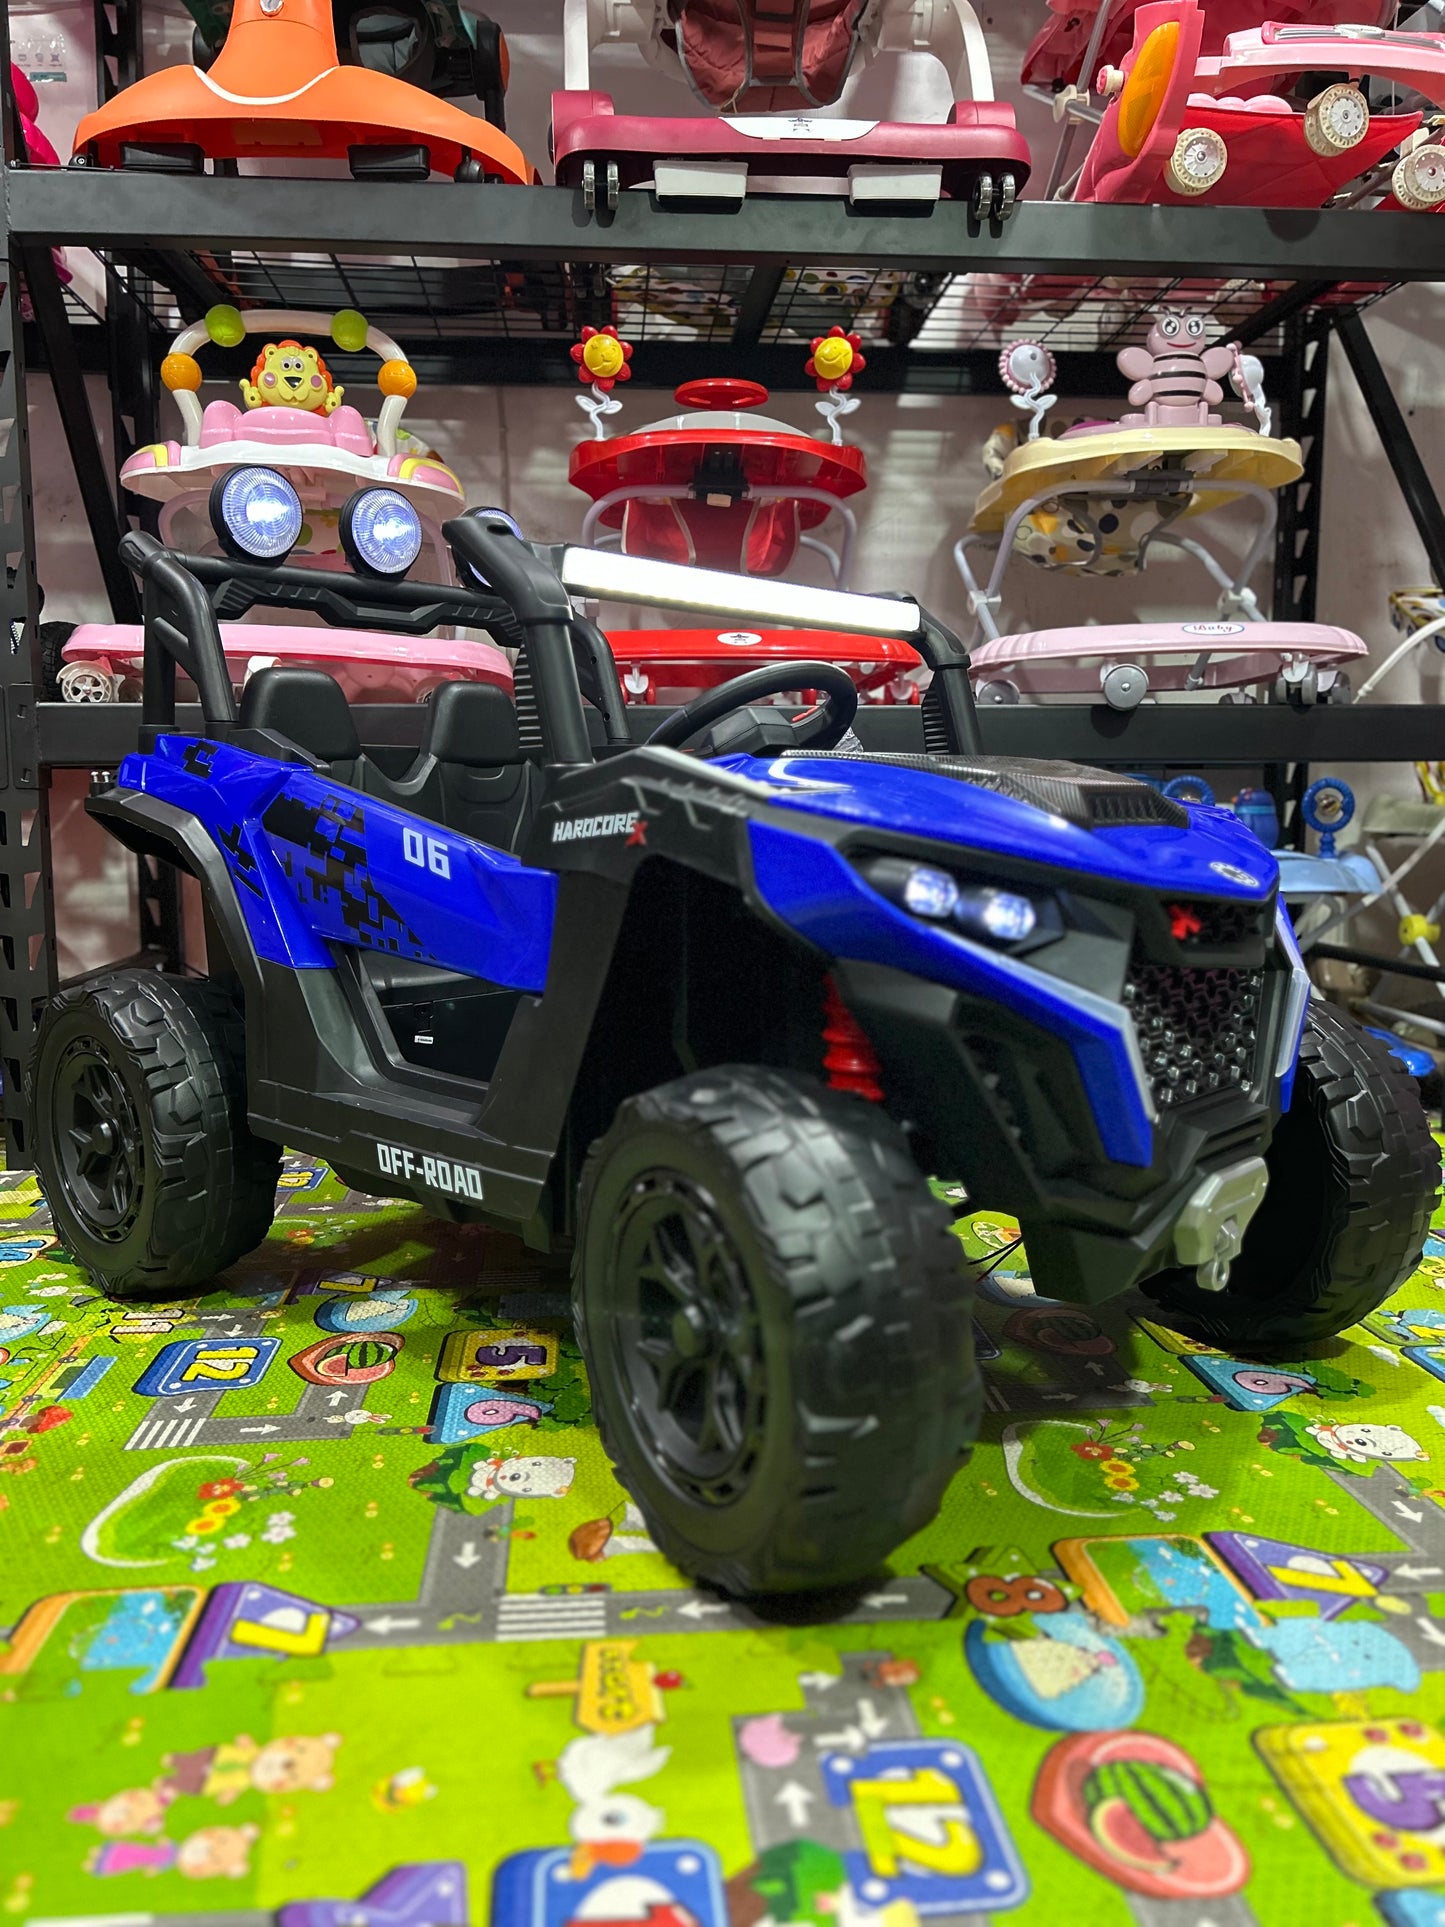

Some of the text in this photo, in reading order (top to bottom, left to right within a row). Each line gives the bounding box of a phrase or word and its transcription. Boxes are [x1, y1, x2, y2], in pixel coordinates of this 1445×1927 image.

[402, 826, 452, 880] 06
[376, 1143, 483, 1200] OFF-ROAD
[110, 1308, 185, 1335] 11
[179, 1346, 259, 1382] 12
[475, 1345, 548, 1367] 5
[1232, 1369, 1319, 1395] 6
[463, 1398, 543, 1426] 6
[965, 1573, 1069, 1617] 8
[1265, 1558, 1379, 1598] 7
[229, 1611, 333, 1657] 7
[849, 1766, 984, 1879] 12
